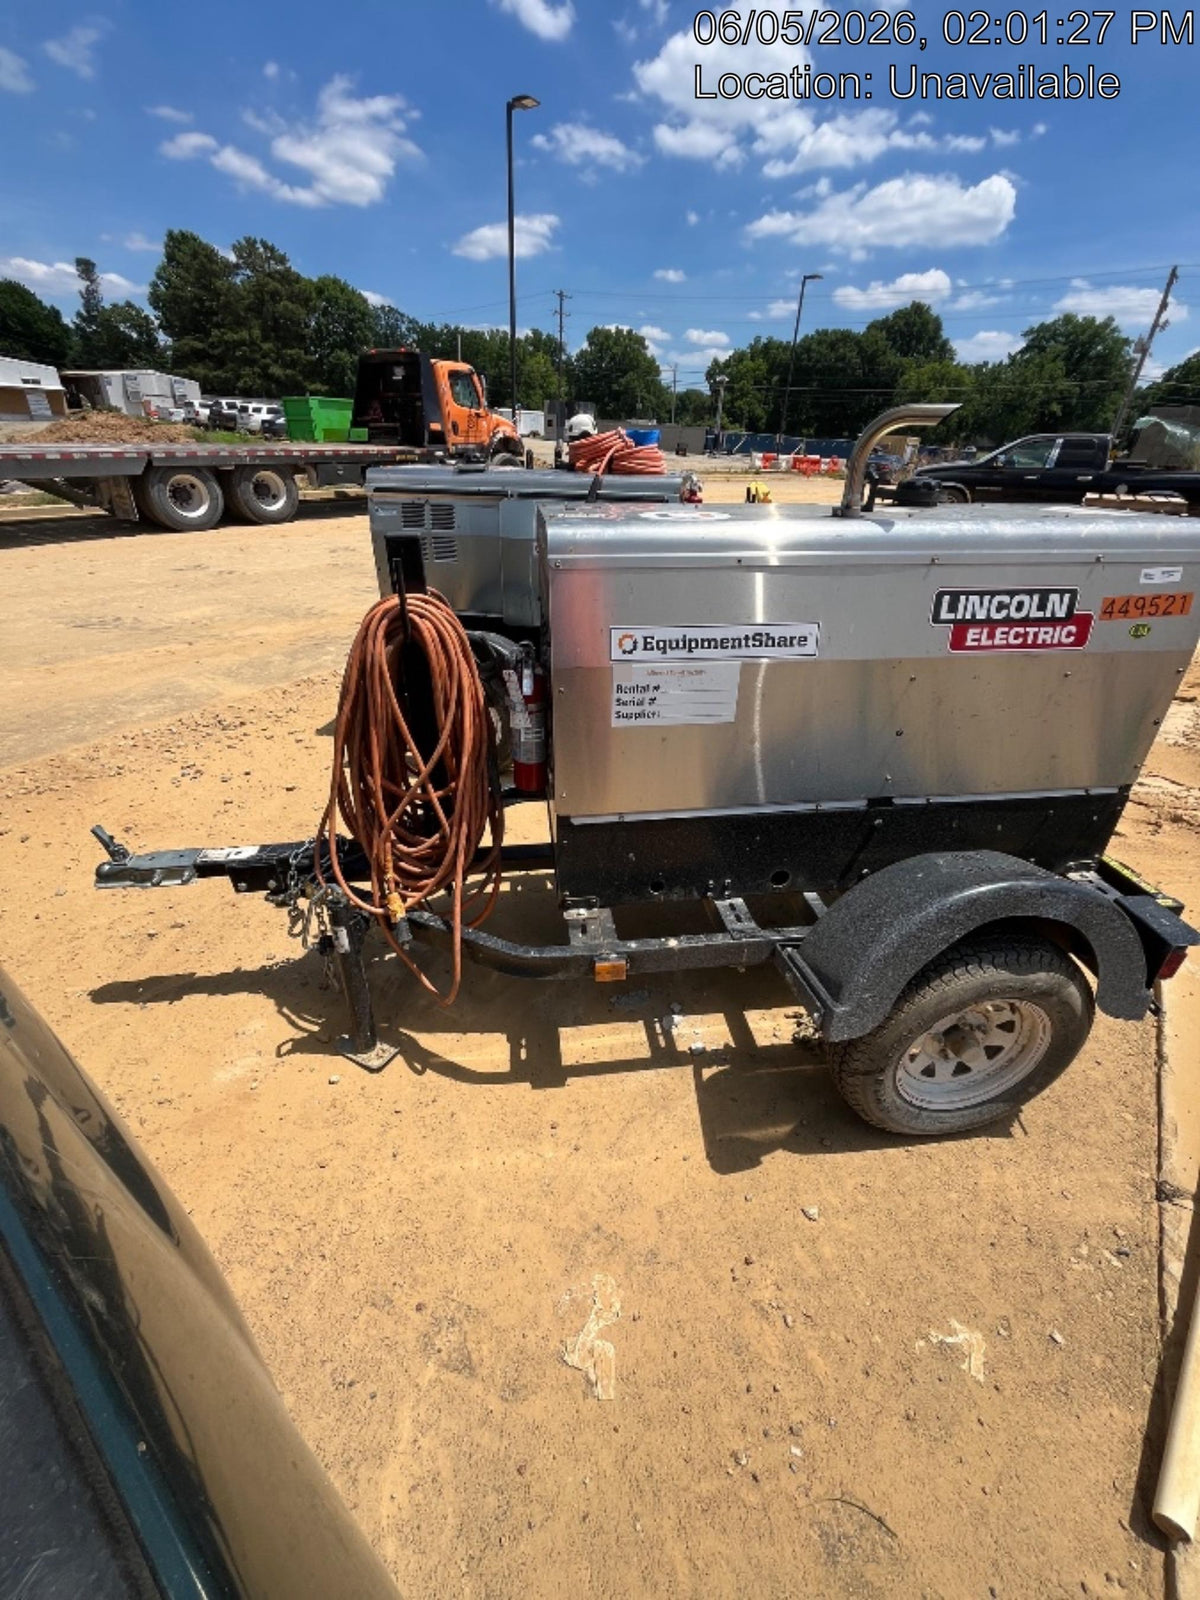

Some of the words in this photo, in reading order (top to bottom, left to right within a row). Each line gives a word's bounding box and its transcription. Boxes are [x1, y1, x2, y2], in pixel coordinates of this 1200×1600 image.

[939, 593, 1072, 620] LINCOLN
[1103, 594, 1188, 618] 449521
[641, 632, 809, 654] EquipmentShare
[965, 625, 1078, 646] ELECTRIC
[616, 684, 650, 694] Rental
[615, 697, 645, 706] Serial
